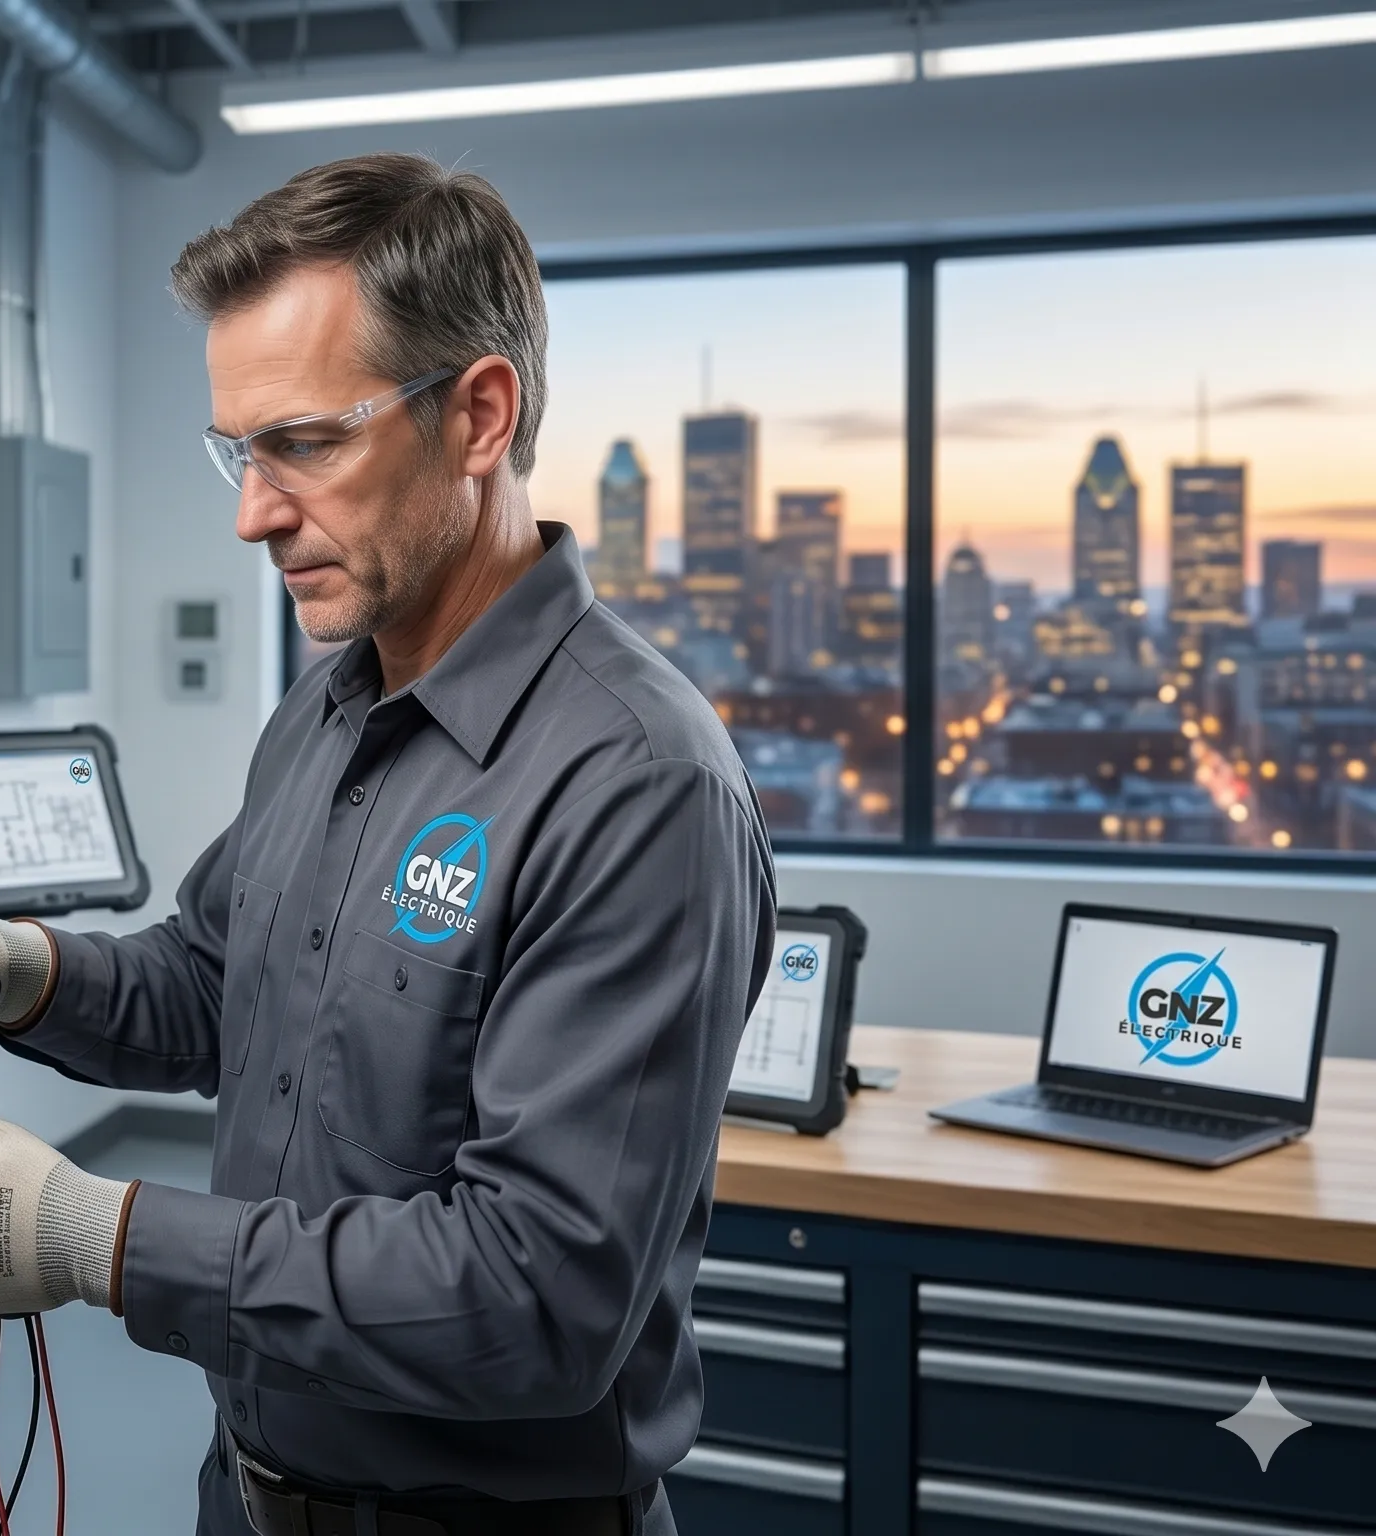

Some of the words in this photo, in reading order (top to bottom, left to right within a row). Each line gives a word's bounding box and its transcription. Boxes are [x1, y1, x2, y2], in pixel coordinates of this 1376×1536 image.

[406, 854, 477, 909] GNZ
[381, 884, 477, 935] ÉLECTRIQUE
[1139, 988, 1226, 1027] GNZ
[1118, 1019, 1243, 1049] ÉLECTRIQUE
